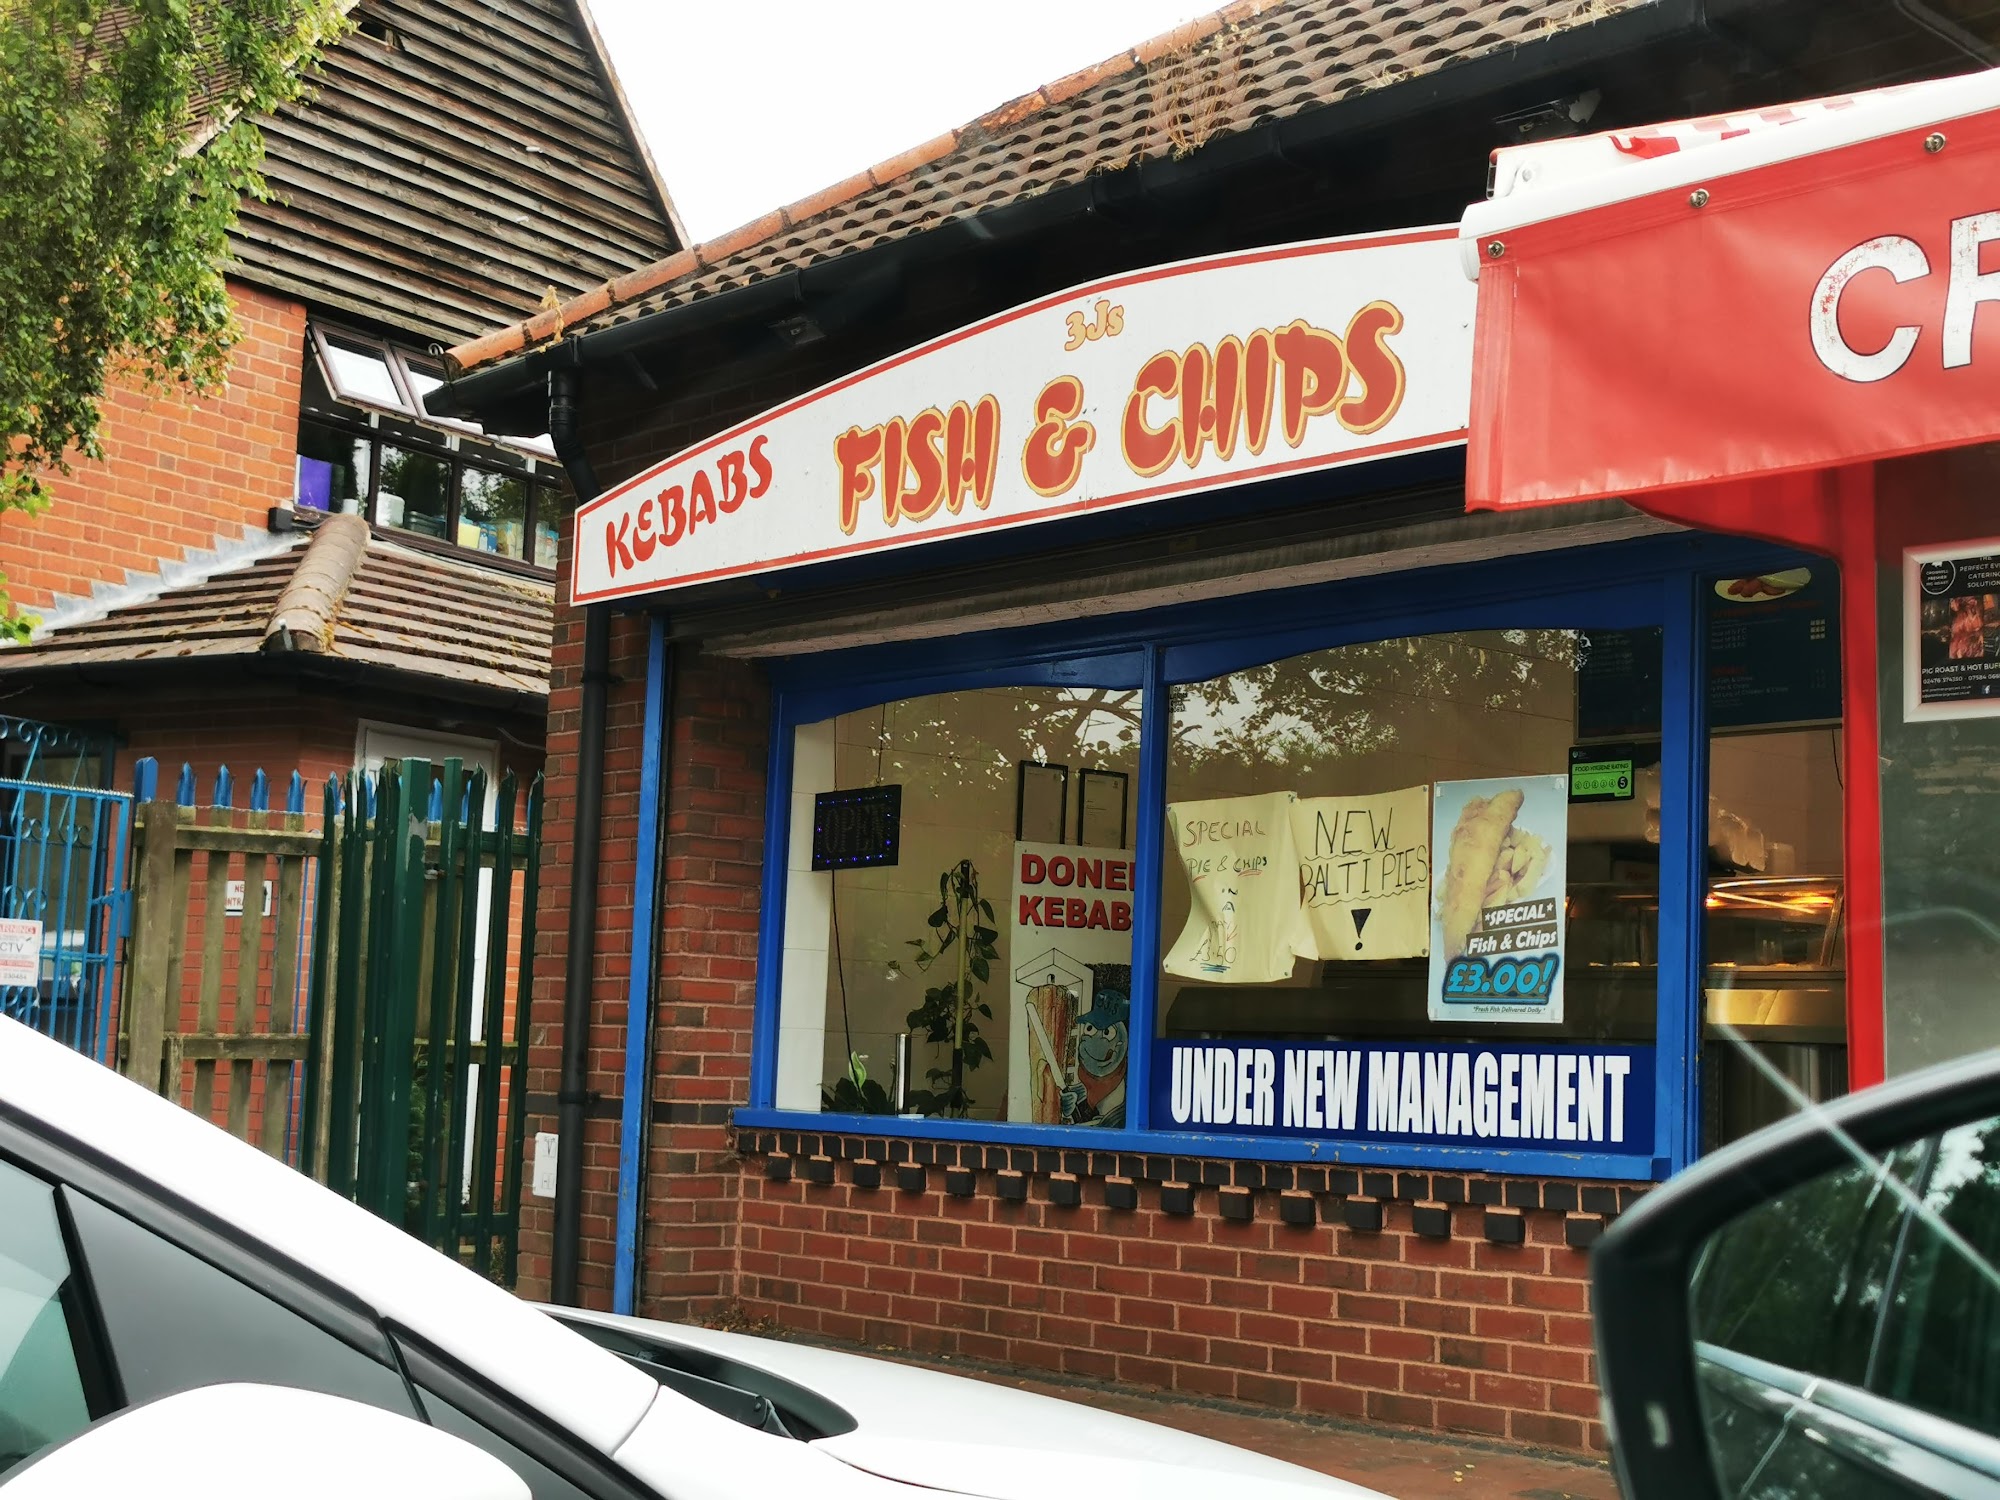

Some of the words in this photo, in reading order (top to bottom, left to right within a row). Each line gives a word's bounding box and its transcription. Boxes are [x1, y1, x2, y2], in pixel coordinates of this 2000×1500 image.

[833, 394, 1001, 536] FISH
[1021, 375, 1096, 497] &
[1121, 300, 1406, 478] CHIPS
[605, 435, 773, 578] KEBABS
[1959, 564, 1989, 572] PERFECT
[1934, 665, 1959, 674] ROAST
[1967, 663, 1983, 671] HOT
[1183, 820, 1267, 847] SPECIAL
[1315, 807, 1396, 856] NEW
[1186, 856, 1211, 878] PIE
[1217, 855, 1229, 872] &
[1233, 855, 1267, 873] CHIPS
[1301, 857, 1371, 903] BALTI
[1382, 845, 1428, 890] PIES
[1018, 895, 1134, 931] KEBAB
[1468, 936, 1497, 955] Fish
[1500, 933, 1512, 950] &
[1515, 929, 1557, 949] Chips
[1447, 959, 1554, 994] £3.00!
[1171, 1046, 1276, 1127] UNDER
[1283, 1049, 1361, 1131] NEW
[1367, 1051, 1631, 1143] MANAGEMENT
